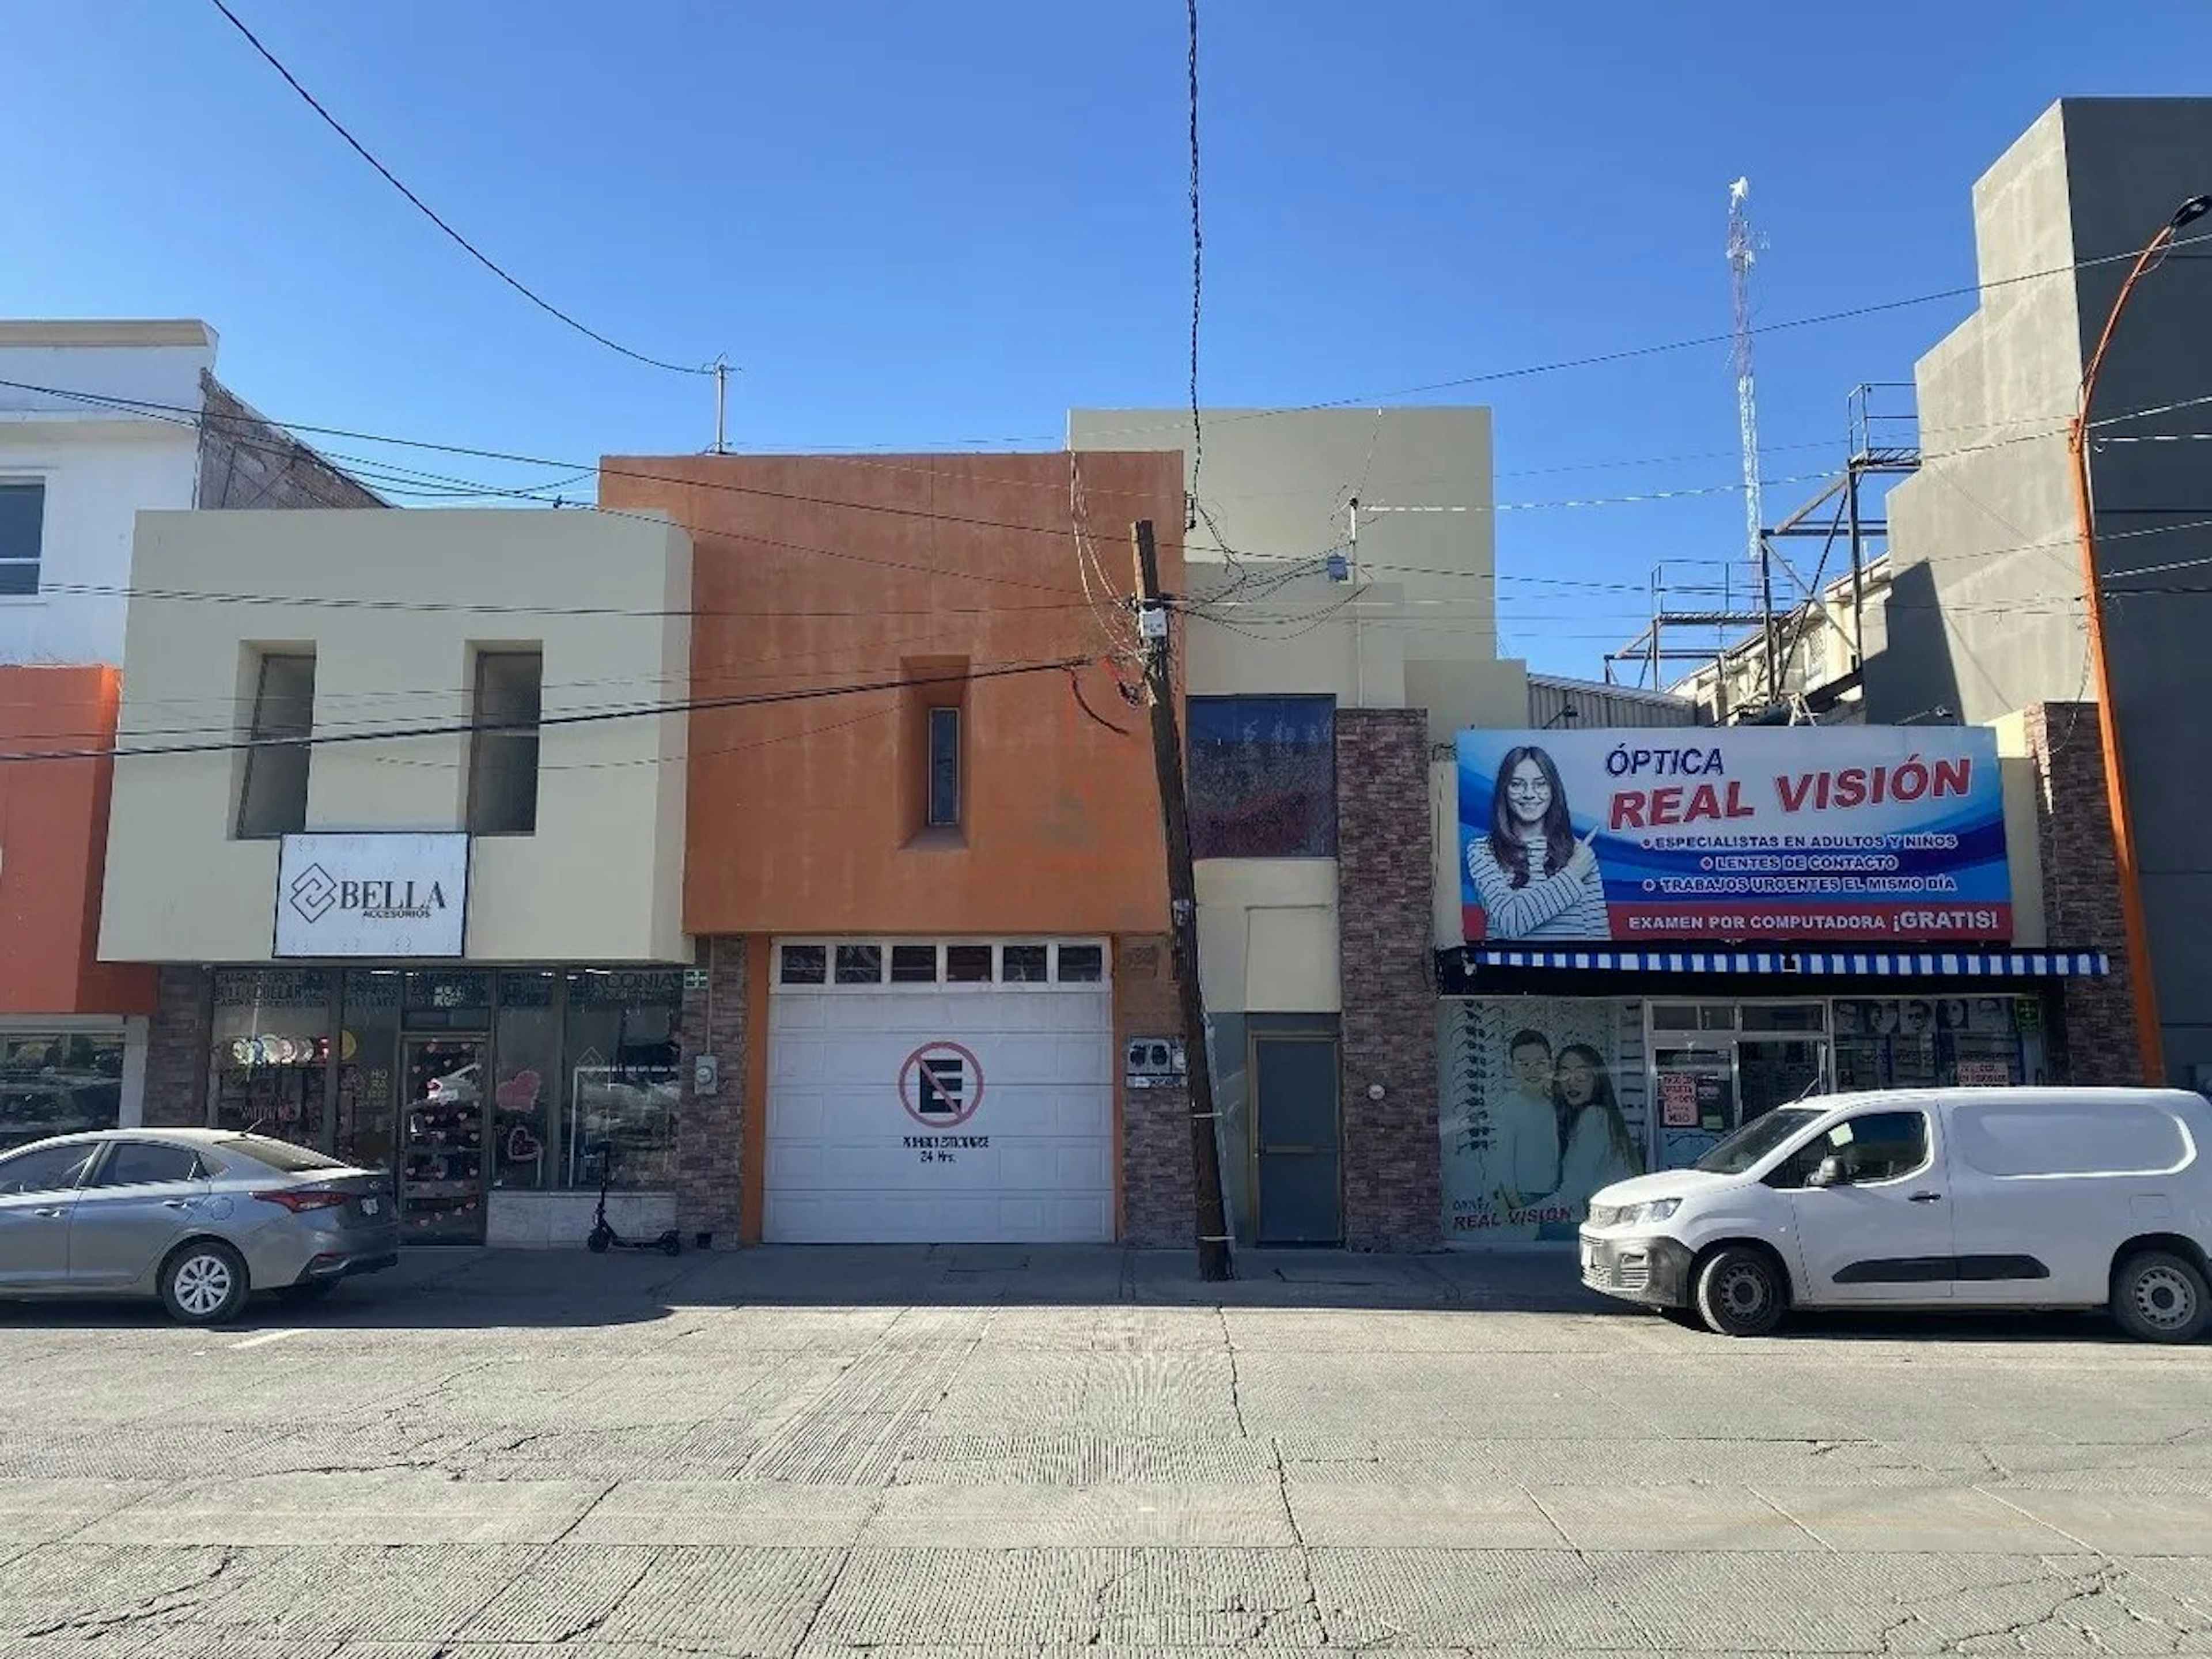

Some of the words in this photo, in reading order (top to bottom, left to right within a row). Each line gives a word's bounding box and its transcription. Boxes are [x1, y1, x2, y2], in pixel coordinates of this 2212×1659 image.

[1607, 743, 1724, 775] ÓPTICA
[1610, 781, 1755, 830] REAL
[1777, 753, 1971, 812] VISIÓN
[1655, 836, 1779, 849] ESPECIALISTAS
[1785, 836, 1805, 848] EN
[1810, 835, 1883, 848] ADULTOS
[1887, 835, 1900, 848] Y
[1904, 833, 1958, 849] NIÑOS
[1717, 857, 1780, 869] LENTES
[1783, 856, 1806, 869] DE
[1809, 855, 1899, 869] CONTACTO
[1661, 878, 1748, 892] TRABAJOS
[1845, 878, 1867, 891] EL
[1869, 878, 1924, 891] MISMO
[1927, 874, 1956, 891] DÍA
[340, 881, 446, 910] BELLA
[362, 910, 431, 919] ACCESORIOS
[1628, 916, 1703, 929] EXAMEN
[1709, 916, 1745, 929] POR
[1750, 915, 1886, 929] COMPUTADORA
[1893, 911, 1998, 932] ¡GRATIS!
[920, 1150, 933, 1162] 24
[1453, 1211, 1501, 1231] REAL
